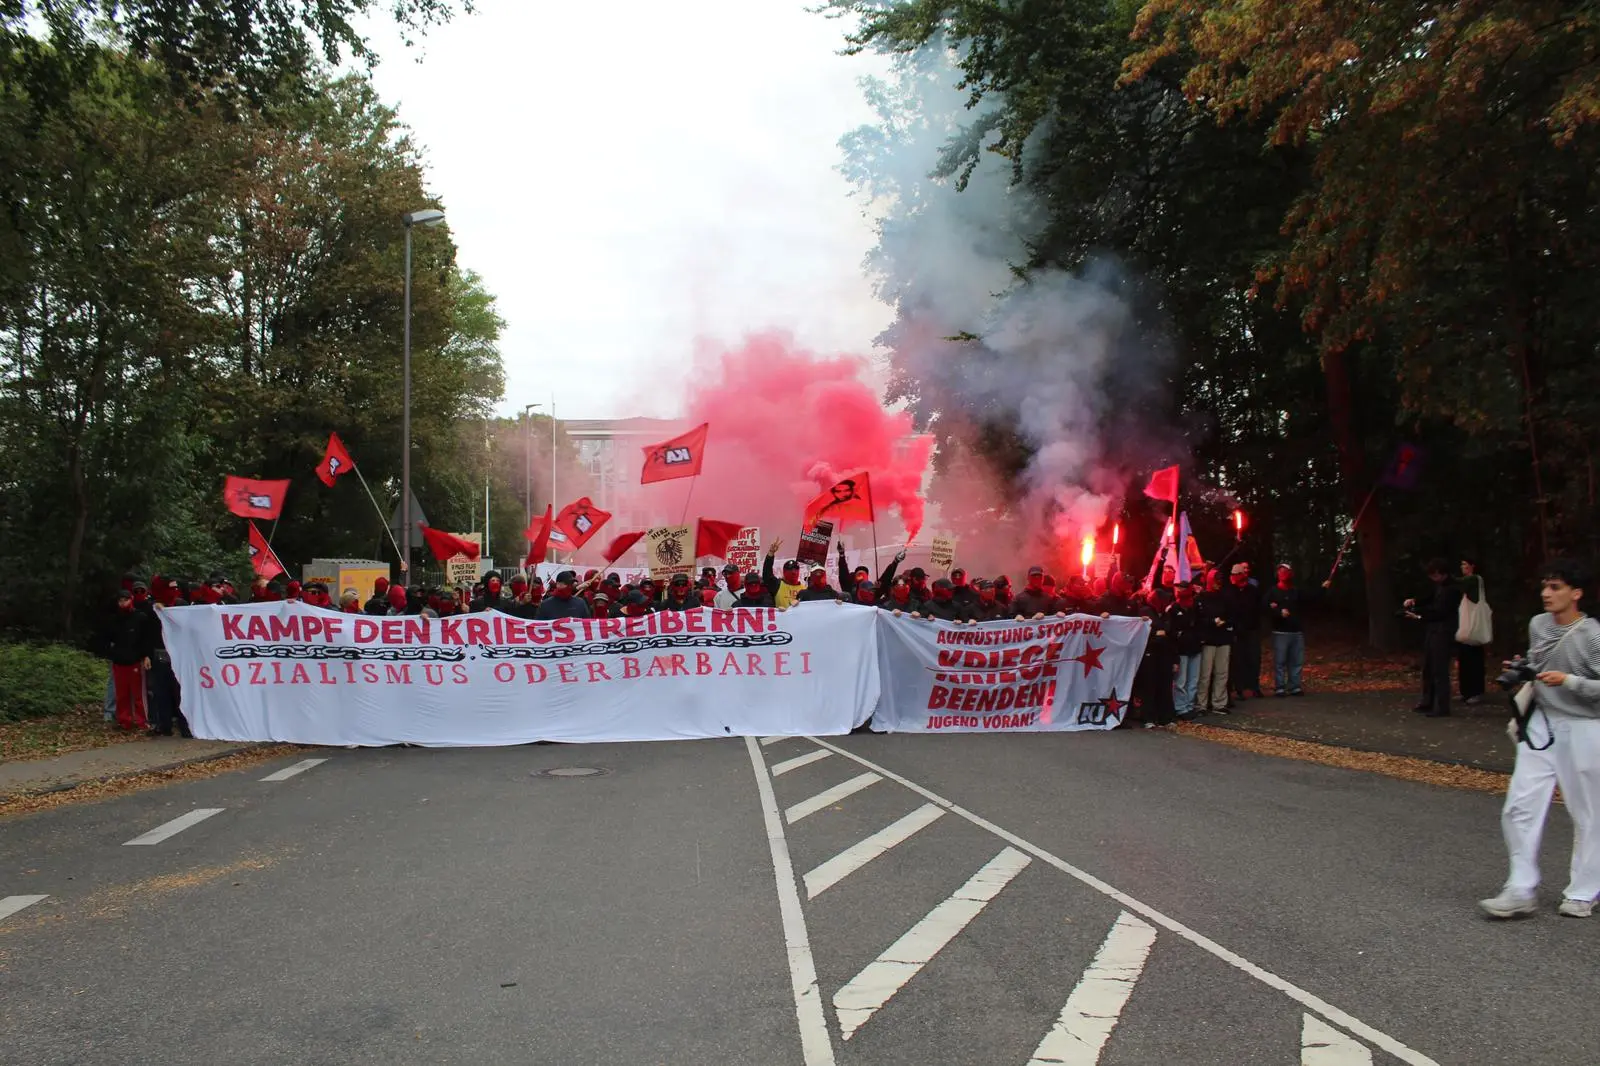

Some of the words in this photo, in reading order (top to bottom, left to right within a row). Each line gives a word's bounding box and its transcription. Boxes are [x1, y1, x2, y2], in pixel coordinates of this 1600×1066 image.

[221, 614, 343, 643] KAMPF
[354, 619, 430, 645] DEN
[441, 607, 777, 646] KRIEGSTREIBERN!
[937, 627, 1033, 645] AUFRÜSTUNG
[1037, 619, 1103, 638] STOPPEN,
[200, 661, 469, 689] SOZIALISMUS
[493, 661, 612, 685] ODER
[621, 650, 813, 679] BARBAREI
[927, 680, 1057, 712] BEENDEN!
[927, 716, 978, 729] JUGEND
[983, 712, 1035, 729] VORAN!
